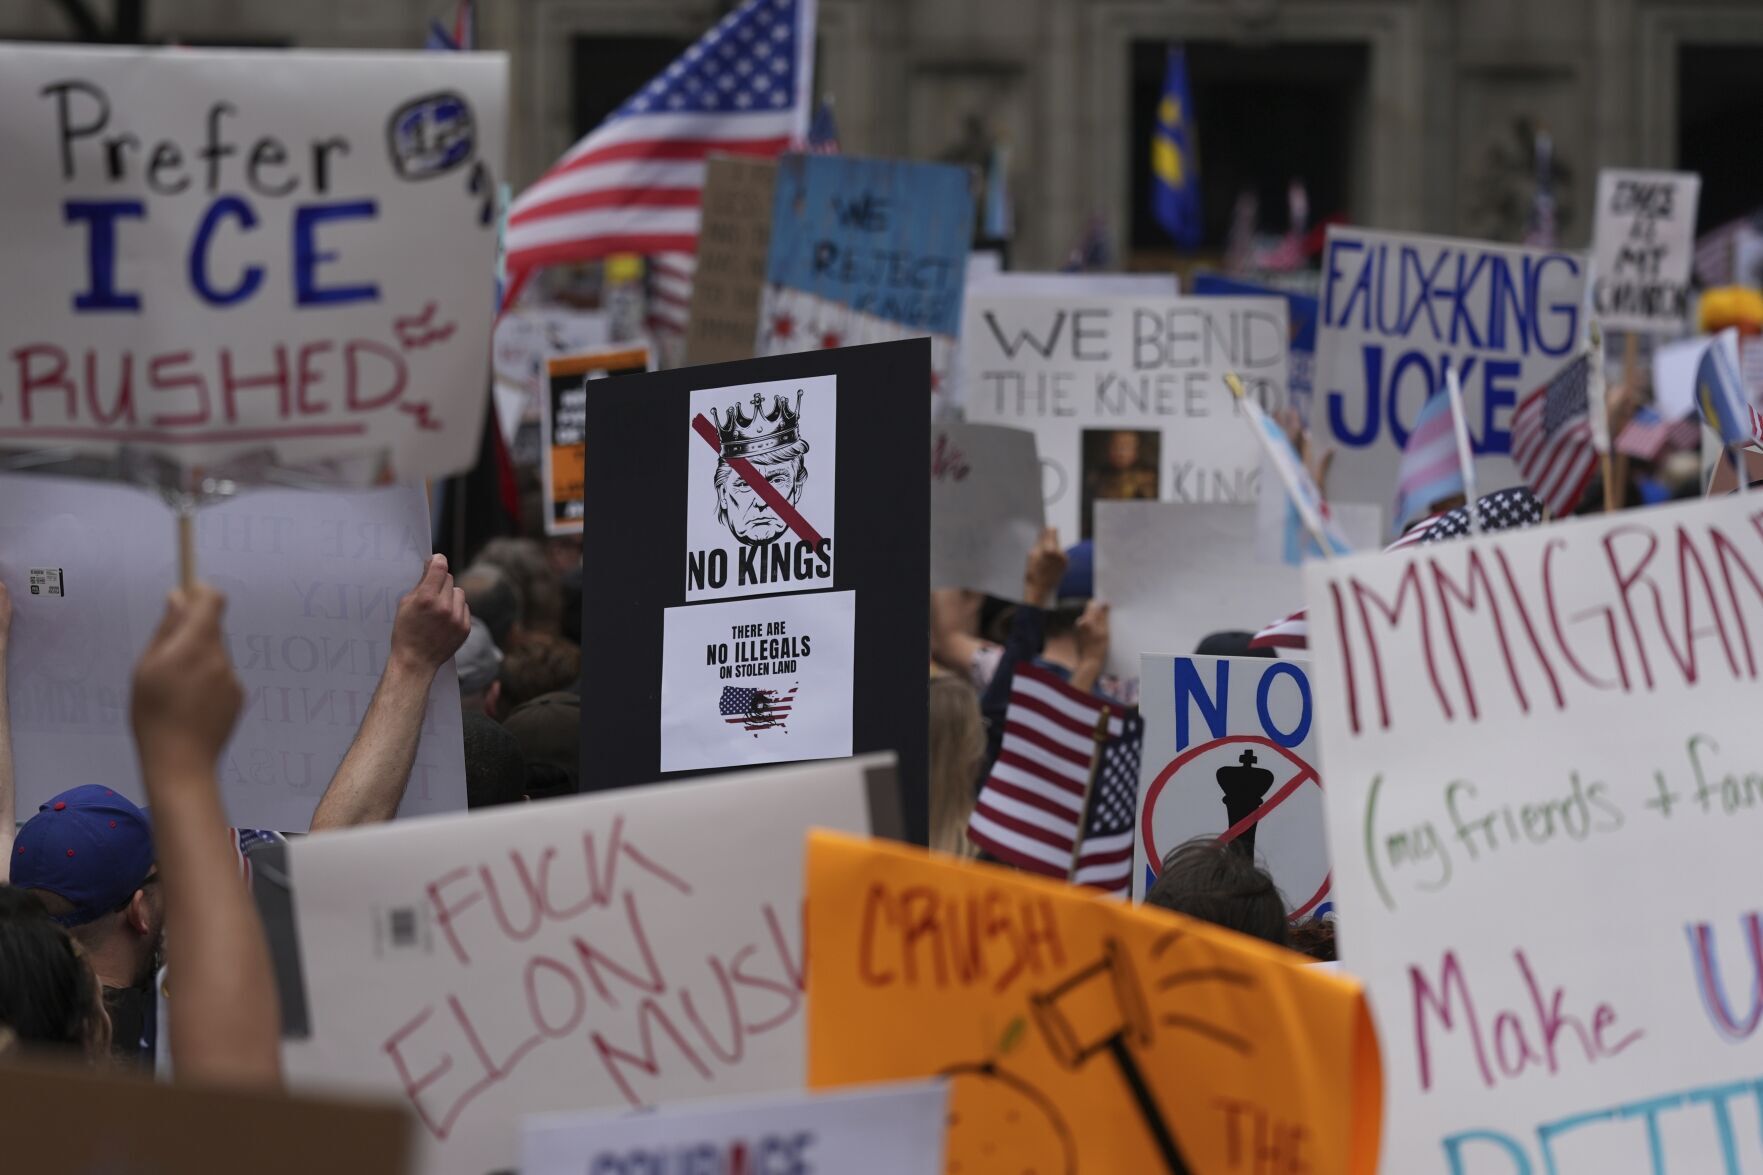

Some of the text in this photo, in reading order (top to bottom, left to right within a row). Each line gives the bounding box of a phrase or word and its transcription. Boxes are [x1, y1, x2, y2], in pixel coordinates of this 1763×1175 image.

[40, 80, 351, 197] Prefer
[62, 194, 382, 313] ICE
[830, 189, 892, 233] WE
[811, 240, 956, 291] REJECT
[1323, 237, 1580, 358] FAUX-KING
[983, 307, 1285, 370] WE BEND
[0, 338, 408, 428] RUSHED
[983, 370, 1077, 416] THE
[1095, 370, 1212, 417] KNEE
[688, 537, 831, 591] NO KINGS
[707, 635, 811, 666] NO ILLEGALS
[719, 659, 797, 680] ON STOLEN LAND
[731, 621, 786, 640] THERE ARE
[1173, 657, 1312, 753] NO
[1445, 778, 1626, 862] friends
[426, 815, 692, 967] FUCK
[860, 881, 1067, 995] CRUSH
[383, 888, 666, 1140] ELON
[1408, 946, 1646, 1093] Make
